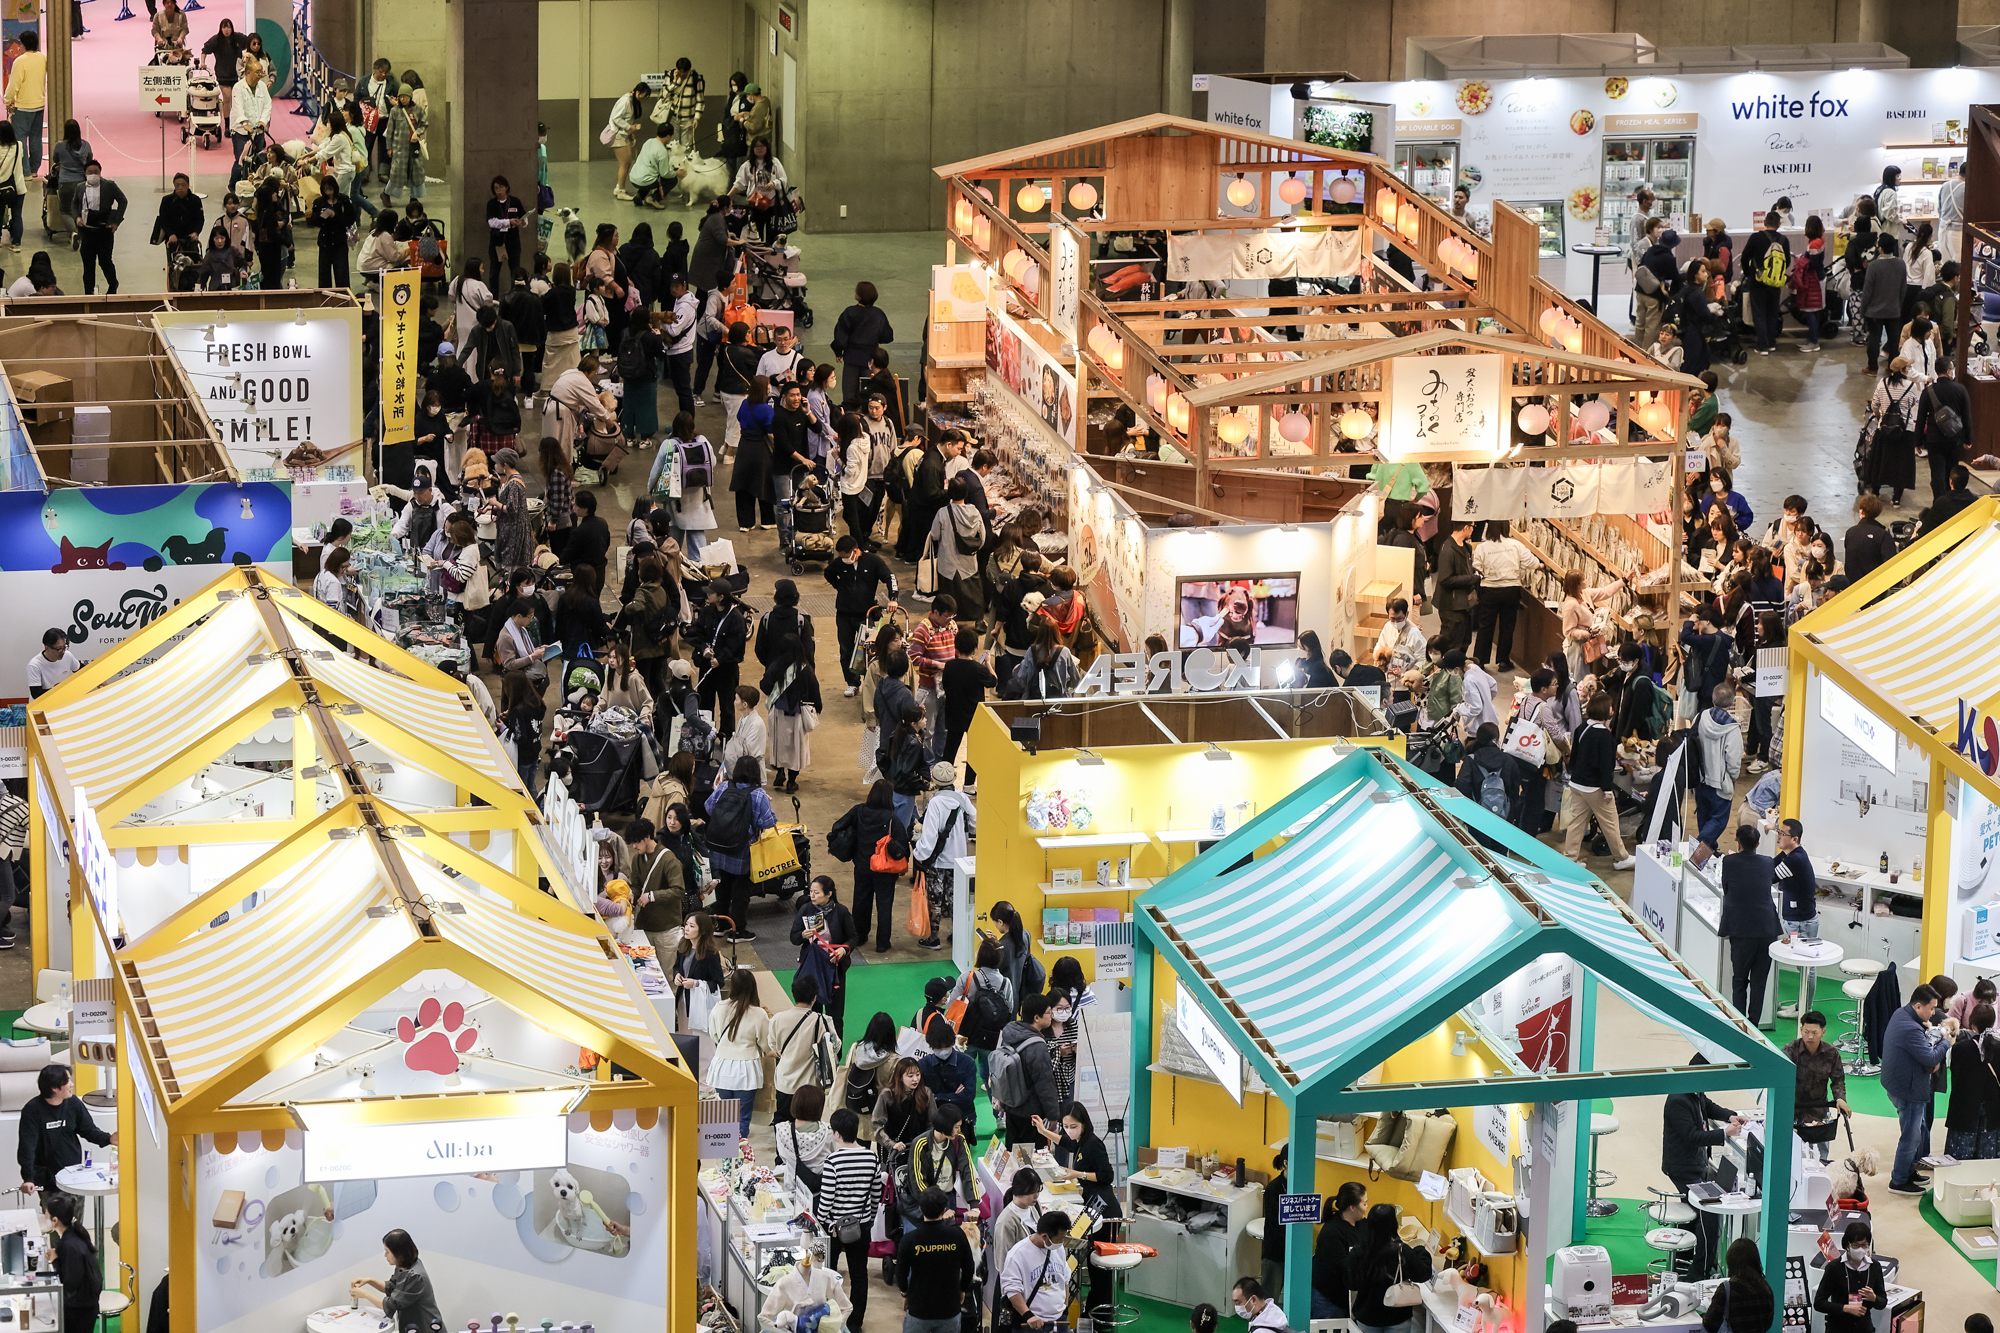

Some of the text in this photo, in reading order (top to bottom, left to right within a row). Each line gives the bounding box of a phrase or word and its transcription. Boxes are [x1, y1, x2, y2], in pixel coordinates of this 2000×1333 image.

[143, 76, 182, 86] 左側通行
[1731, 90, 1849, 120] white fox
[1215, 111, 1262, 129] white fox
[1663, 117, 1687, 125] SERIES
[1886, 109, 1926, 119] BASE DELI
[1409, 123, 1439, 132] LOVABLE
[1441, 123, 1455, 131] DOG
[1763, 163, 1811, 174] BASE DELI
[206, 342, 311, 362] FRESH BOWL
[209, 377, 309, 403] AND GOOD
[1421, 369, 1449, 434] みちのく
[1416, 404, 1427, 438] ファーム
[213, 416, 312, 442] SMILE!
[1113, 960, 1133, 968] Industry
[1201, 1026, 1226, 1065] PUPPING
[584, 1132, 650, 1158] 安全なシャワー器
[1281, 1196, 1321, 1205] ビジネスパートナー
[1283, 1204, 1317, 1213] 探しています
[914, 1243, 957, 1256] PUPPING
